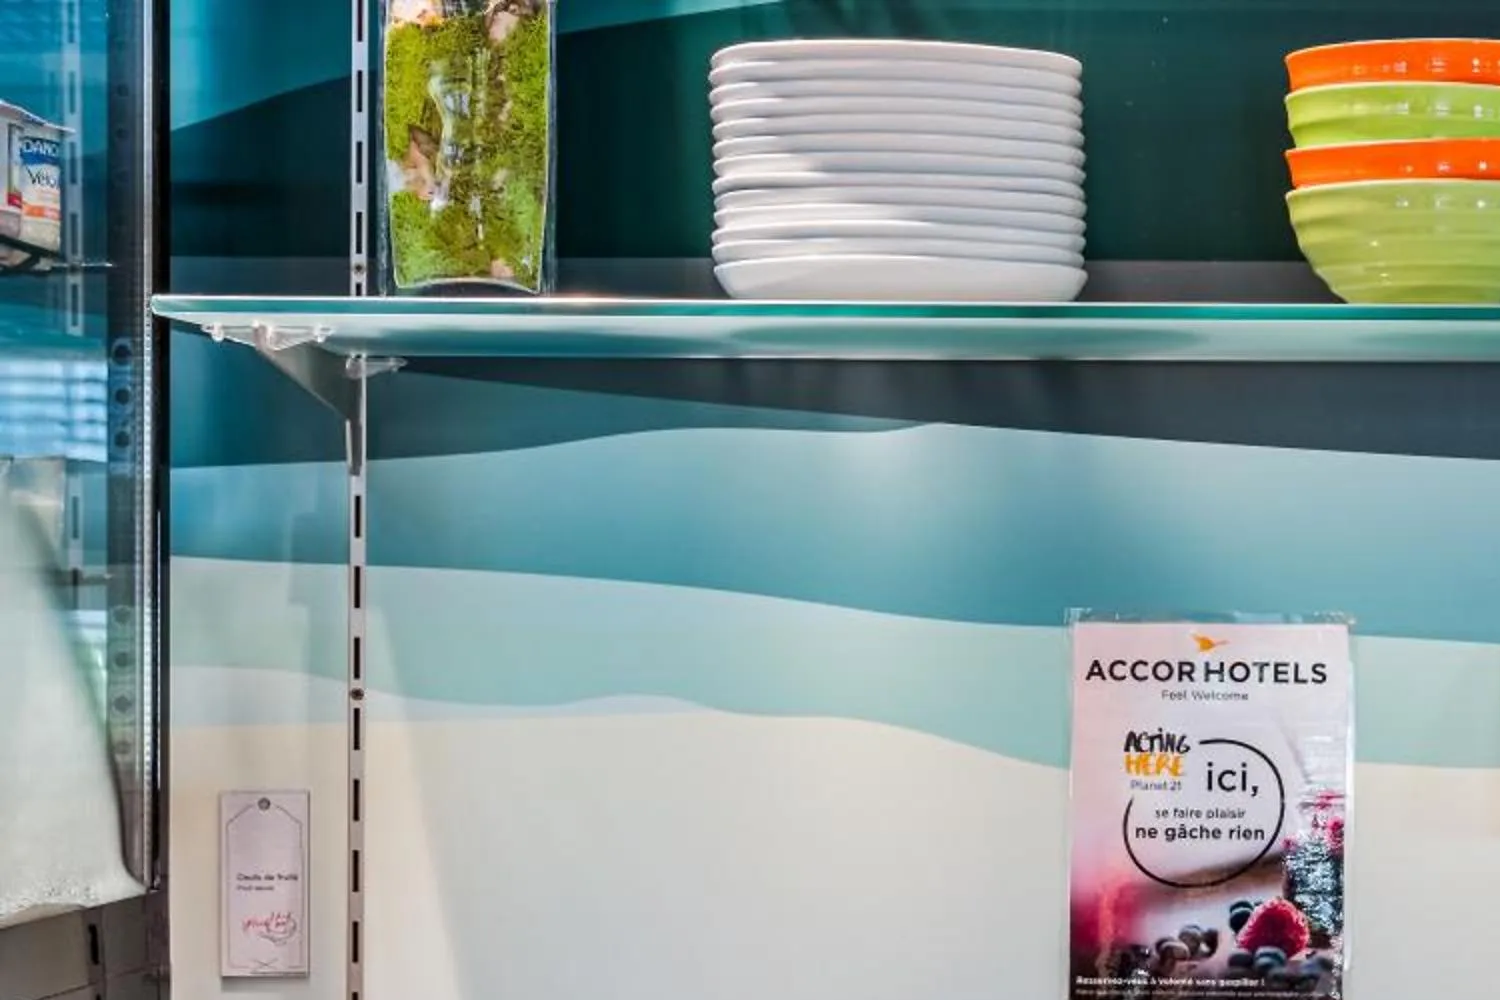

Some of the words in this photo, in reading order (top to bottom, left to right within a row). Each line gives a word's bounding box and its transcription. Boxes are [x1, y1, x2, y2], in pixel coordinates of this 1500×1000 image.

[1161, 689, 1188, 701] Feel
[1192, 690, 1249, 701] Welcome
[1124, 727, 1191, 754] ACTING
[1124, 752, 1185, 778] HERE
[1129, 779, 1168, 791] Planet
[1169, 780, 1182, 791] 21
[1206, 761, 1260, 797] ici,
[1155, 809, 1169, 819] se
[1172, 806, 1202, 819] faire
[1205, 807, 1247, 822] plaisir
[1134, 825, 1159, 839] ne
[1164, 823, 1222, 842] gâche
[1227, 825, 1266, 841] rien
